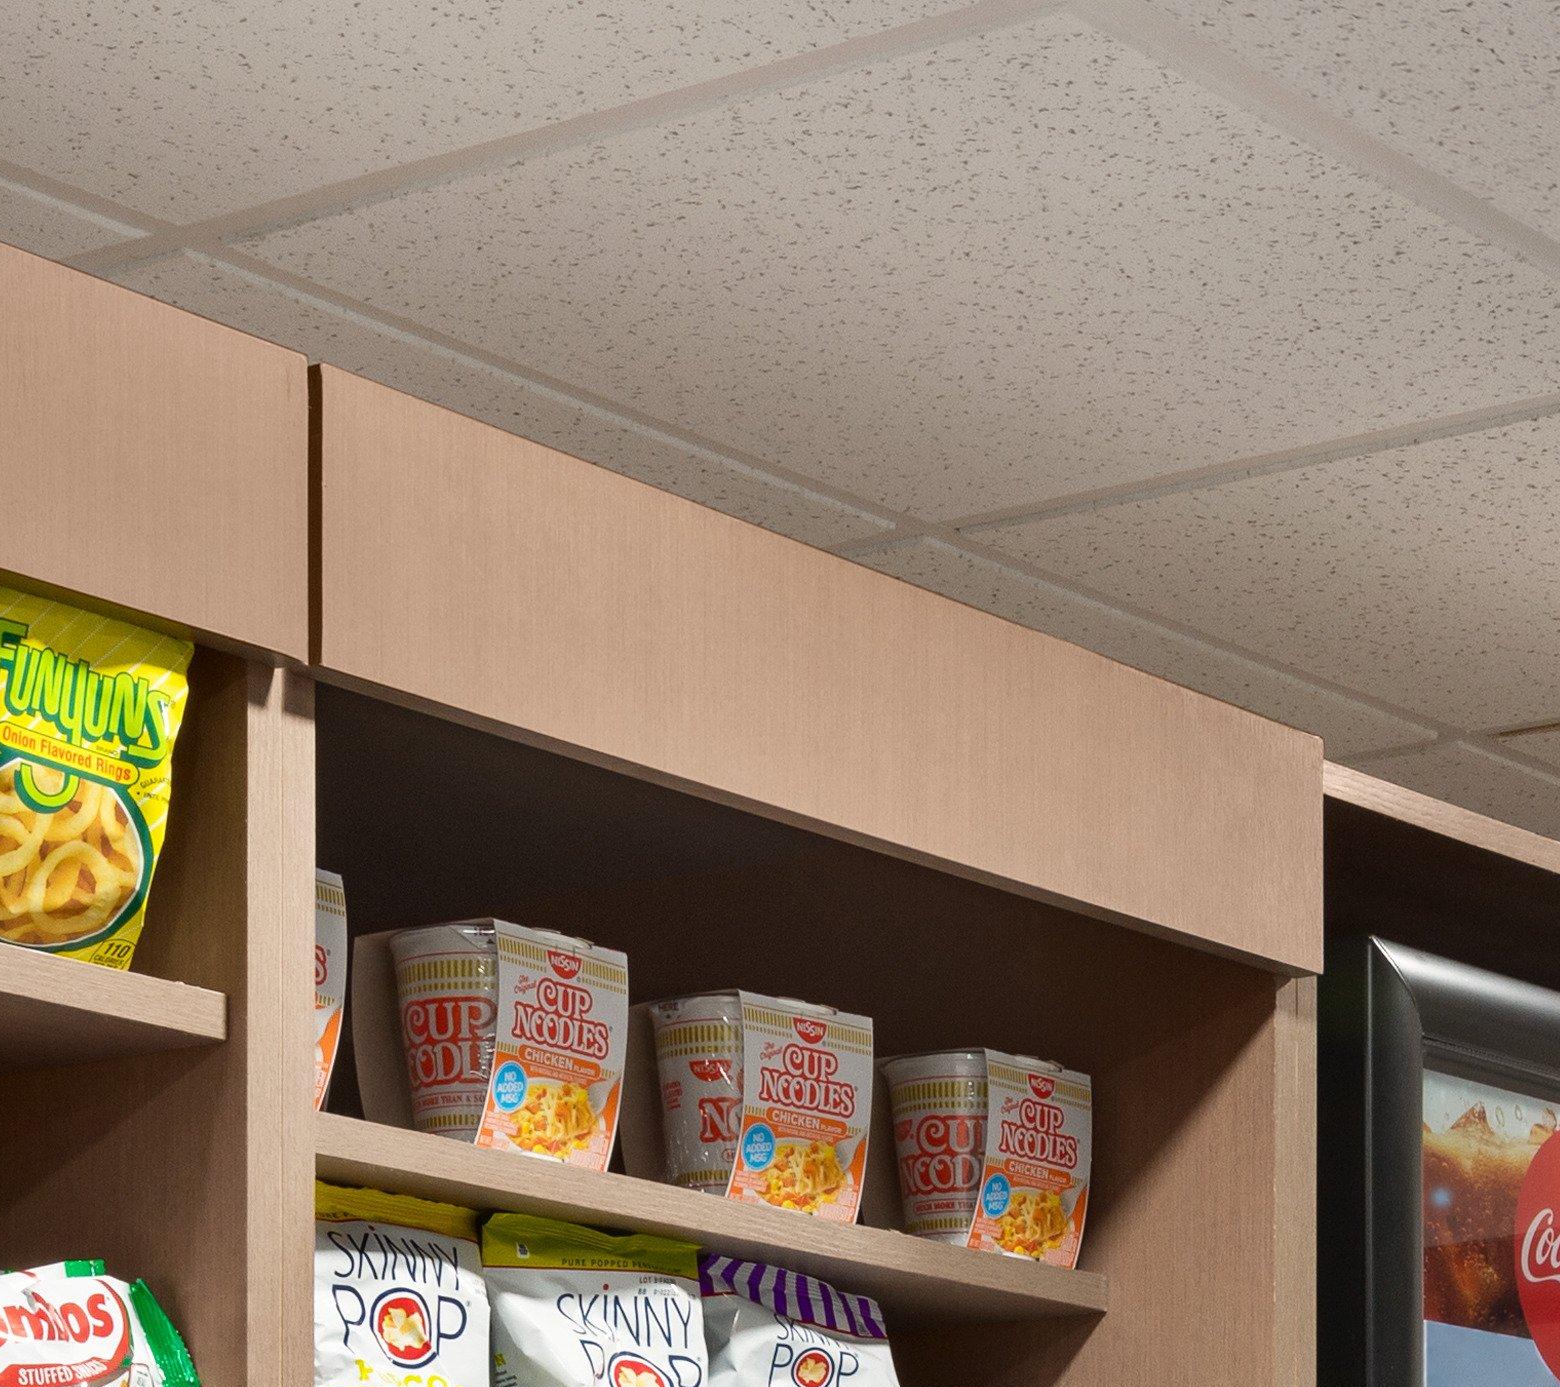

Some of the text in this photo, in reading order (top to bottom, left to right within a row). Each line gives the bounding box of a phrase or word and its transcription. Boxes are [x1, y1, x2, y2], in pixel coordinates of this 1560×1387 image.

[1, 727, 132, 782] Onion Flavored Rings
[103, 941, 131, 960] 110
[538, 978, 593, 1017] CUP
[404, 1000, 490, 1042] CUP
[513, 1001, 609, 1059] NOODLES
[525, 1049, 574, 1070] CHICKEN
[783, 1043, 838, 1080] CUP
[760, 1067, 856, 1117] NOODLES
[771, 1111, 821, 1130] CHICKEN
[1020, 1098, 1064, 1133] CUP
[1000, 1122, 1077, 1169] NOODLES
[1009, 1160, 1049, 1179] CHICKEN
[328, 1226, 461, 1291] SKINNY
[562, 1258, 629, 1269] PURE POPPED
[332, 1285, 468, 1369] POP
[557, 1283, 692, 1348] SKINNY
[18, 1363, 73, 1387] STUFFED
